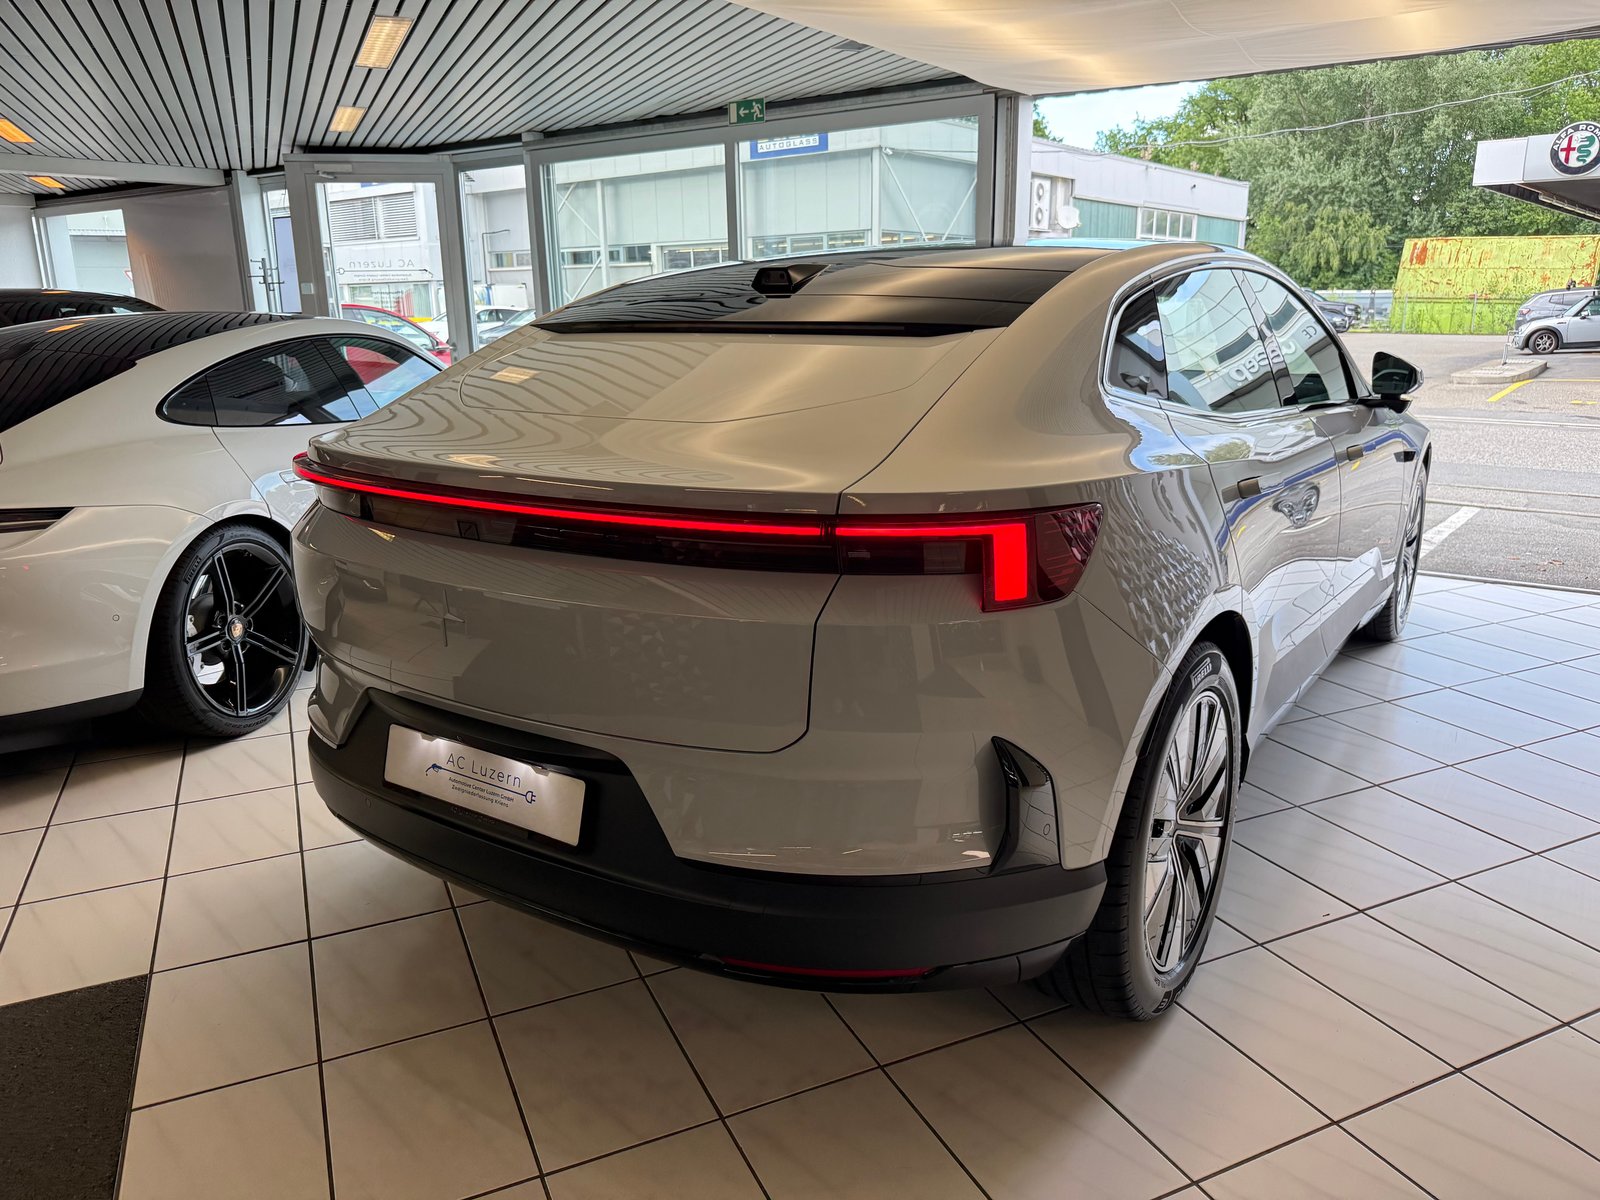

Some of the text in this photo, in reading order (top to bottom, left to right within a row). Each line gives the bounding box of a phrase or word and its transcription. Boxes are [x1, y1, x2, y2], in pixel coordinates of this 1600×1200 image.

[759, 138, 818, 151] AUTOGLASS
[1553, 124, 1600, 150] ALFA ROM
[183, 555, 201, 584] PIRELLI
[1190, 657, 1212, 690] PIRELLI
[446, 752, 522, 788] AC Luzern
[448, 777, 472, 789] Automotive
[485, 788, 501, 799] Luzern
[500, 793, 515, 803] GmbH
